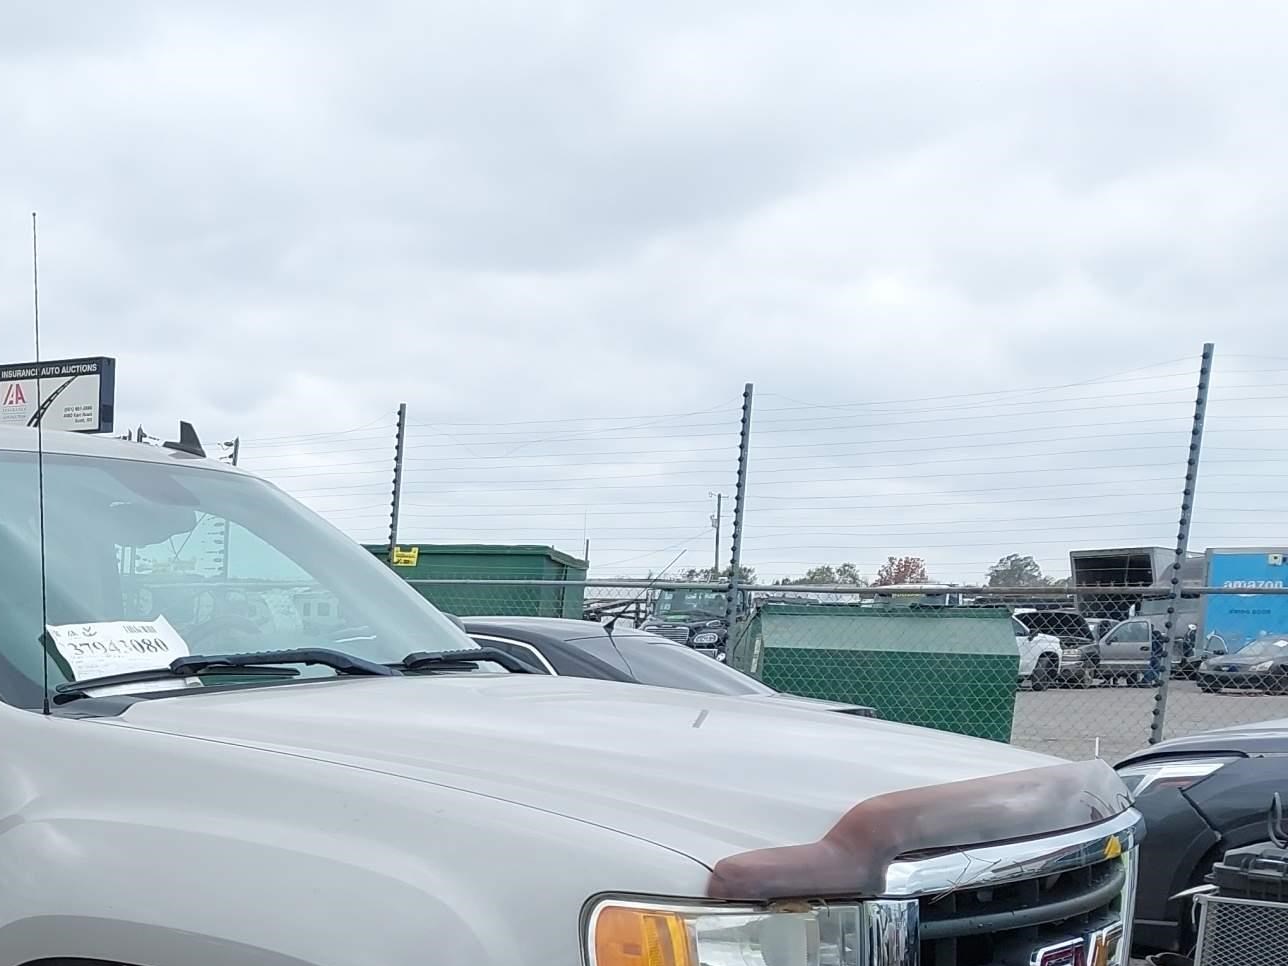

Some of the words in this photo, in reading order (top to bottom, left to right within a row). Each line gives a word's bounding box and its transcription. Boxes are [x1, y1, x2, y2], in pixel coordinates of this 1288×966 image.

[41, 366, 60, 376] AUTO
[61, 363, 97, 375] AUCTIONS
[67, 638, 169, 656] 37943080
